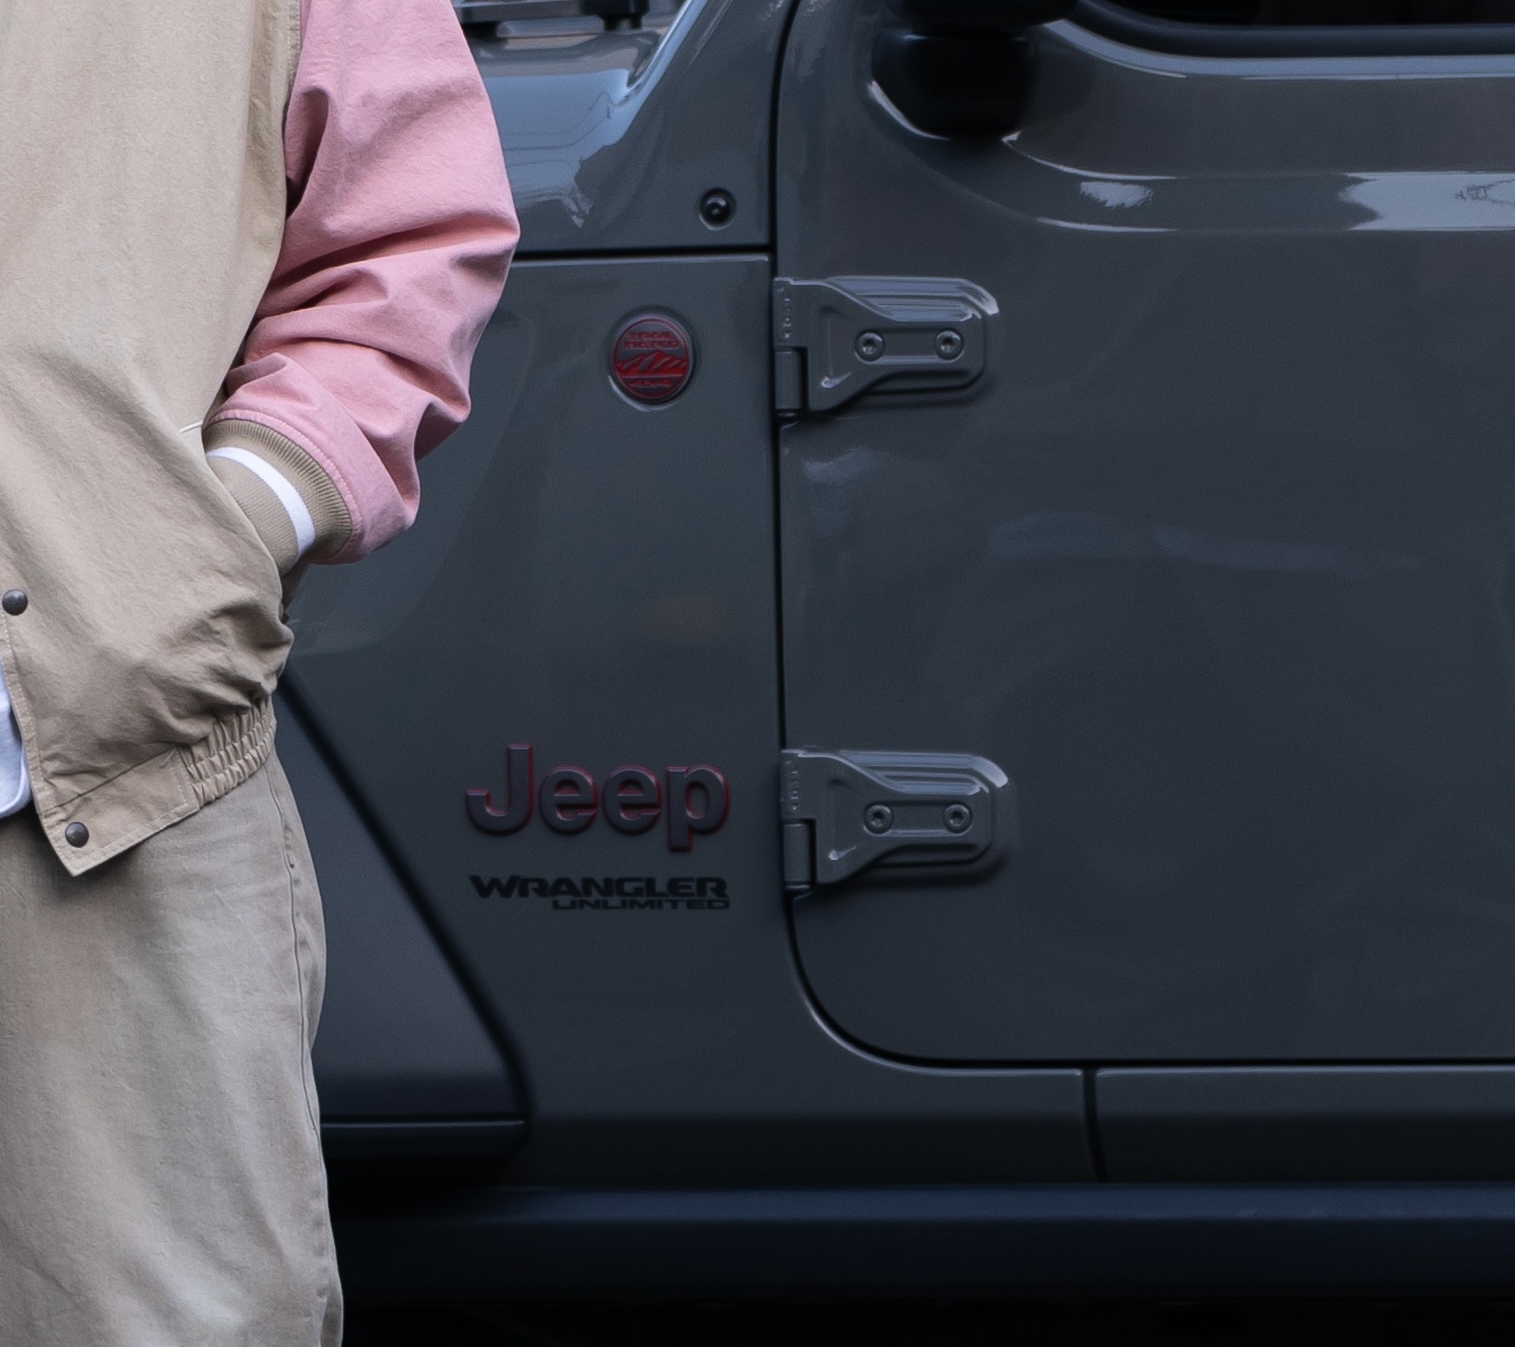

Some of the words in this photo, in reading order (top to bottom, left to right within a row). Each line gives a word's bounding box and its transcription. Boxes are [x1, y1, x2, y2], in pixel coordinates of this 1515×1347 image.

[465, 743, 731, 853] Jeep
[468, 875, 729, 899] WRANGLER
[552, 899, 730, 910] UNLIMITED
